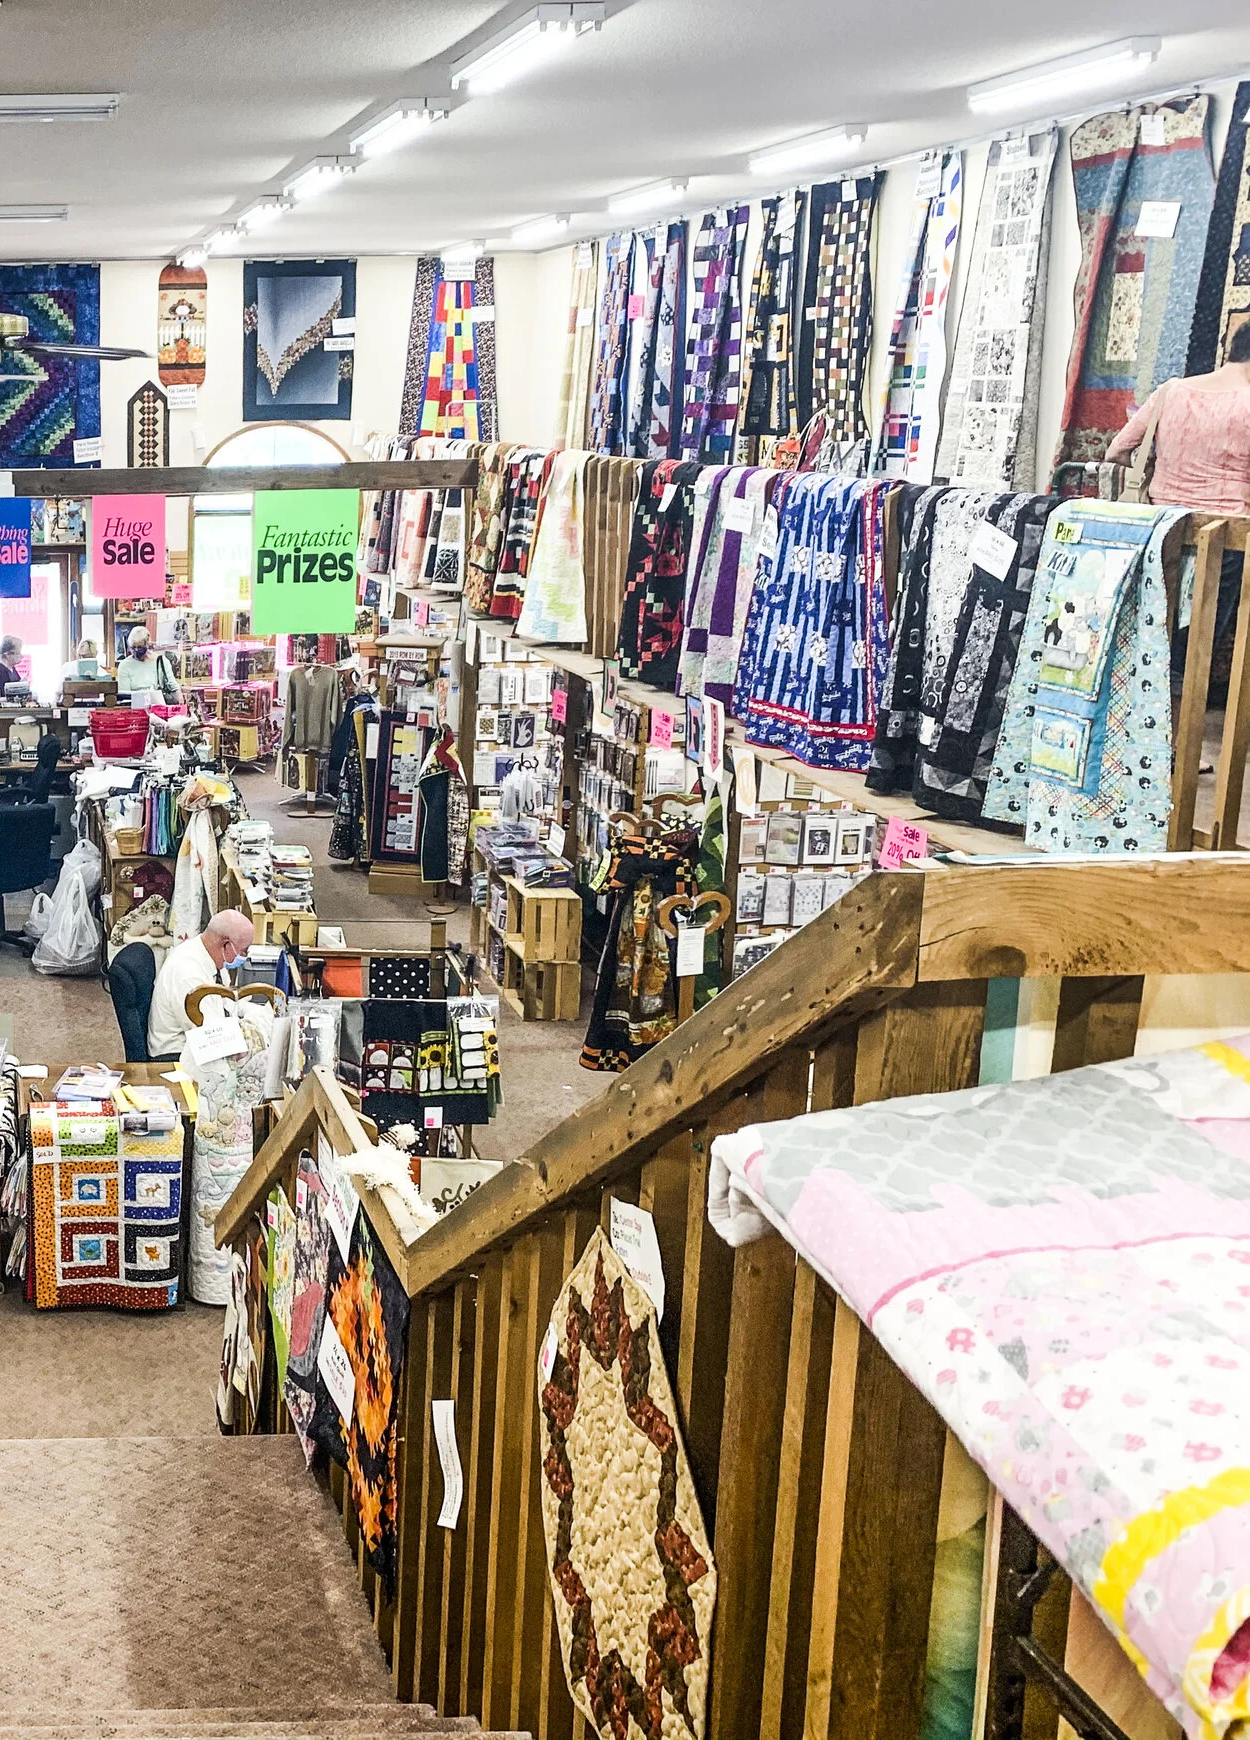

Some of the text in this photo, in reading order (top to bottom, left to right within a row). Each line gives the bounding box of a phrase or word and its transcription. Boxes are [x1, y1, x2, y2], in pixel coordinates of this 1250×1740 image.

[102, 517, 153, 543] Huge
[260, 524, 353, 548] Fantastic
[103, 539, 155, 565] Sale
[257, 547, 354, 584] Prizes
[903, 826, 920, 842] Sale
[886, 841, 904, 861] 20%
